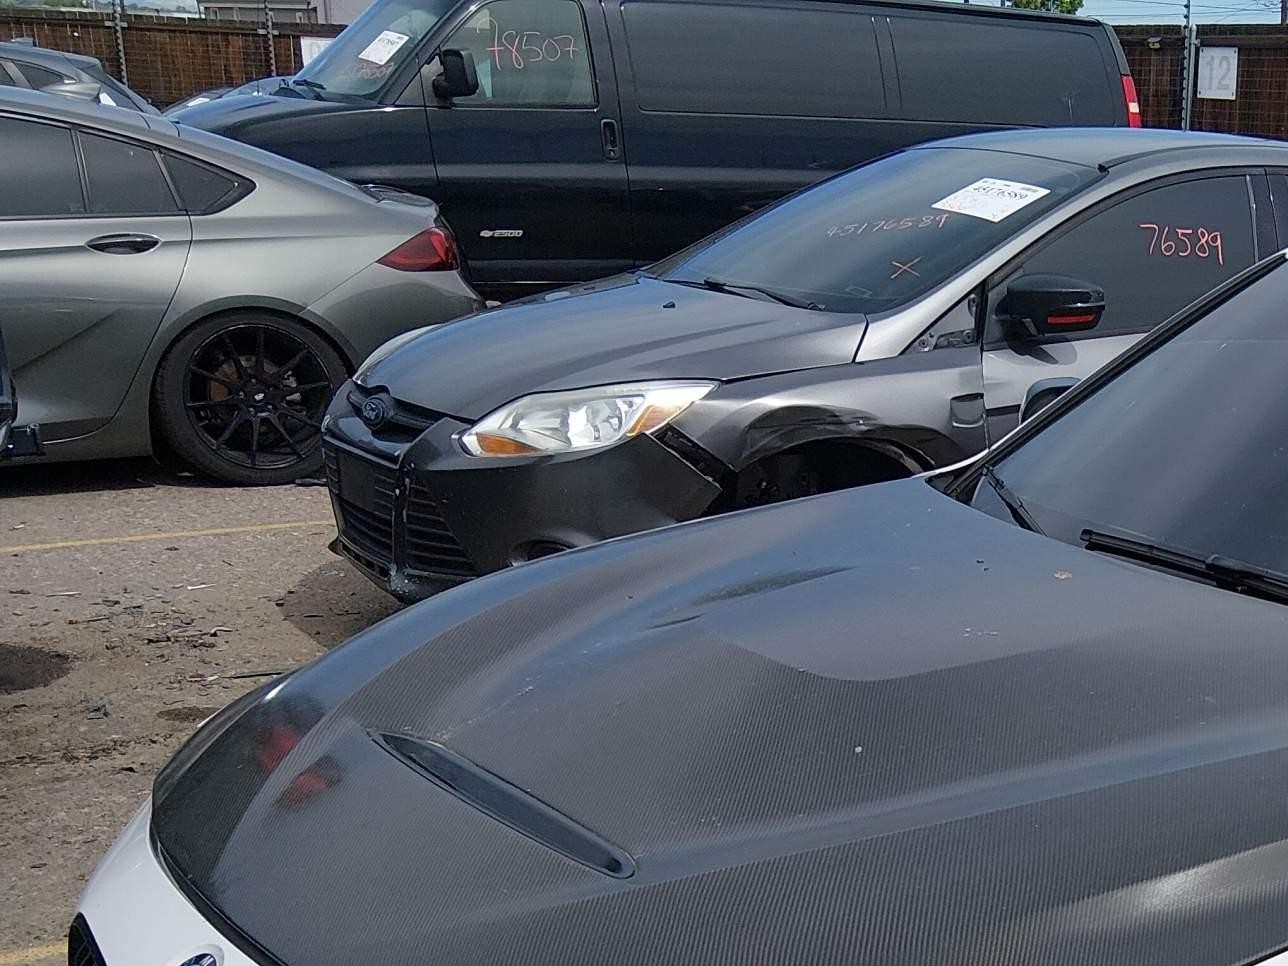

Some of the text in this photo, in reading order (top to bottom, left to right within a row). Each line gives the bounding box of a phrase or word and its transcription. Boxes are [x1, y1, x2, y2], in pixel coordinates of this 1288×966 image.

[476, 17, 579, 71] 78507
[1206, 55, 1230, 90] 12
[1139, 224, 1224, 266] 76589
